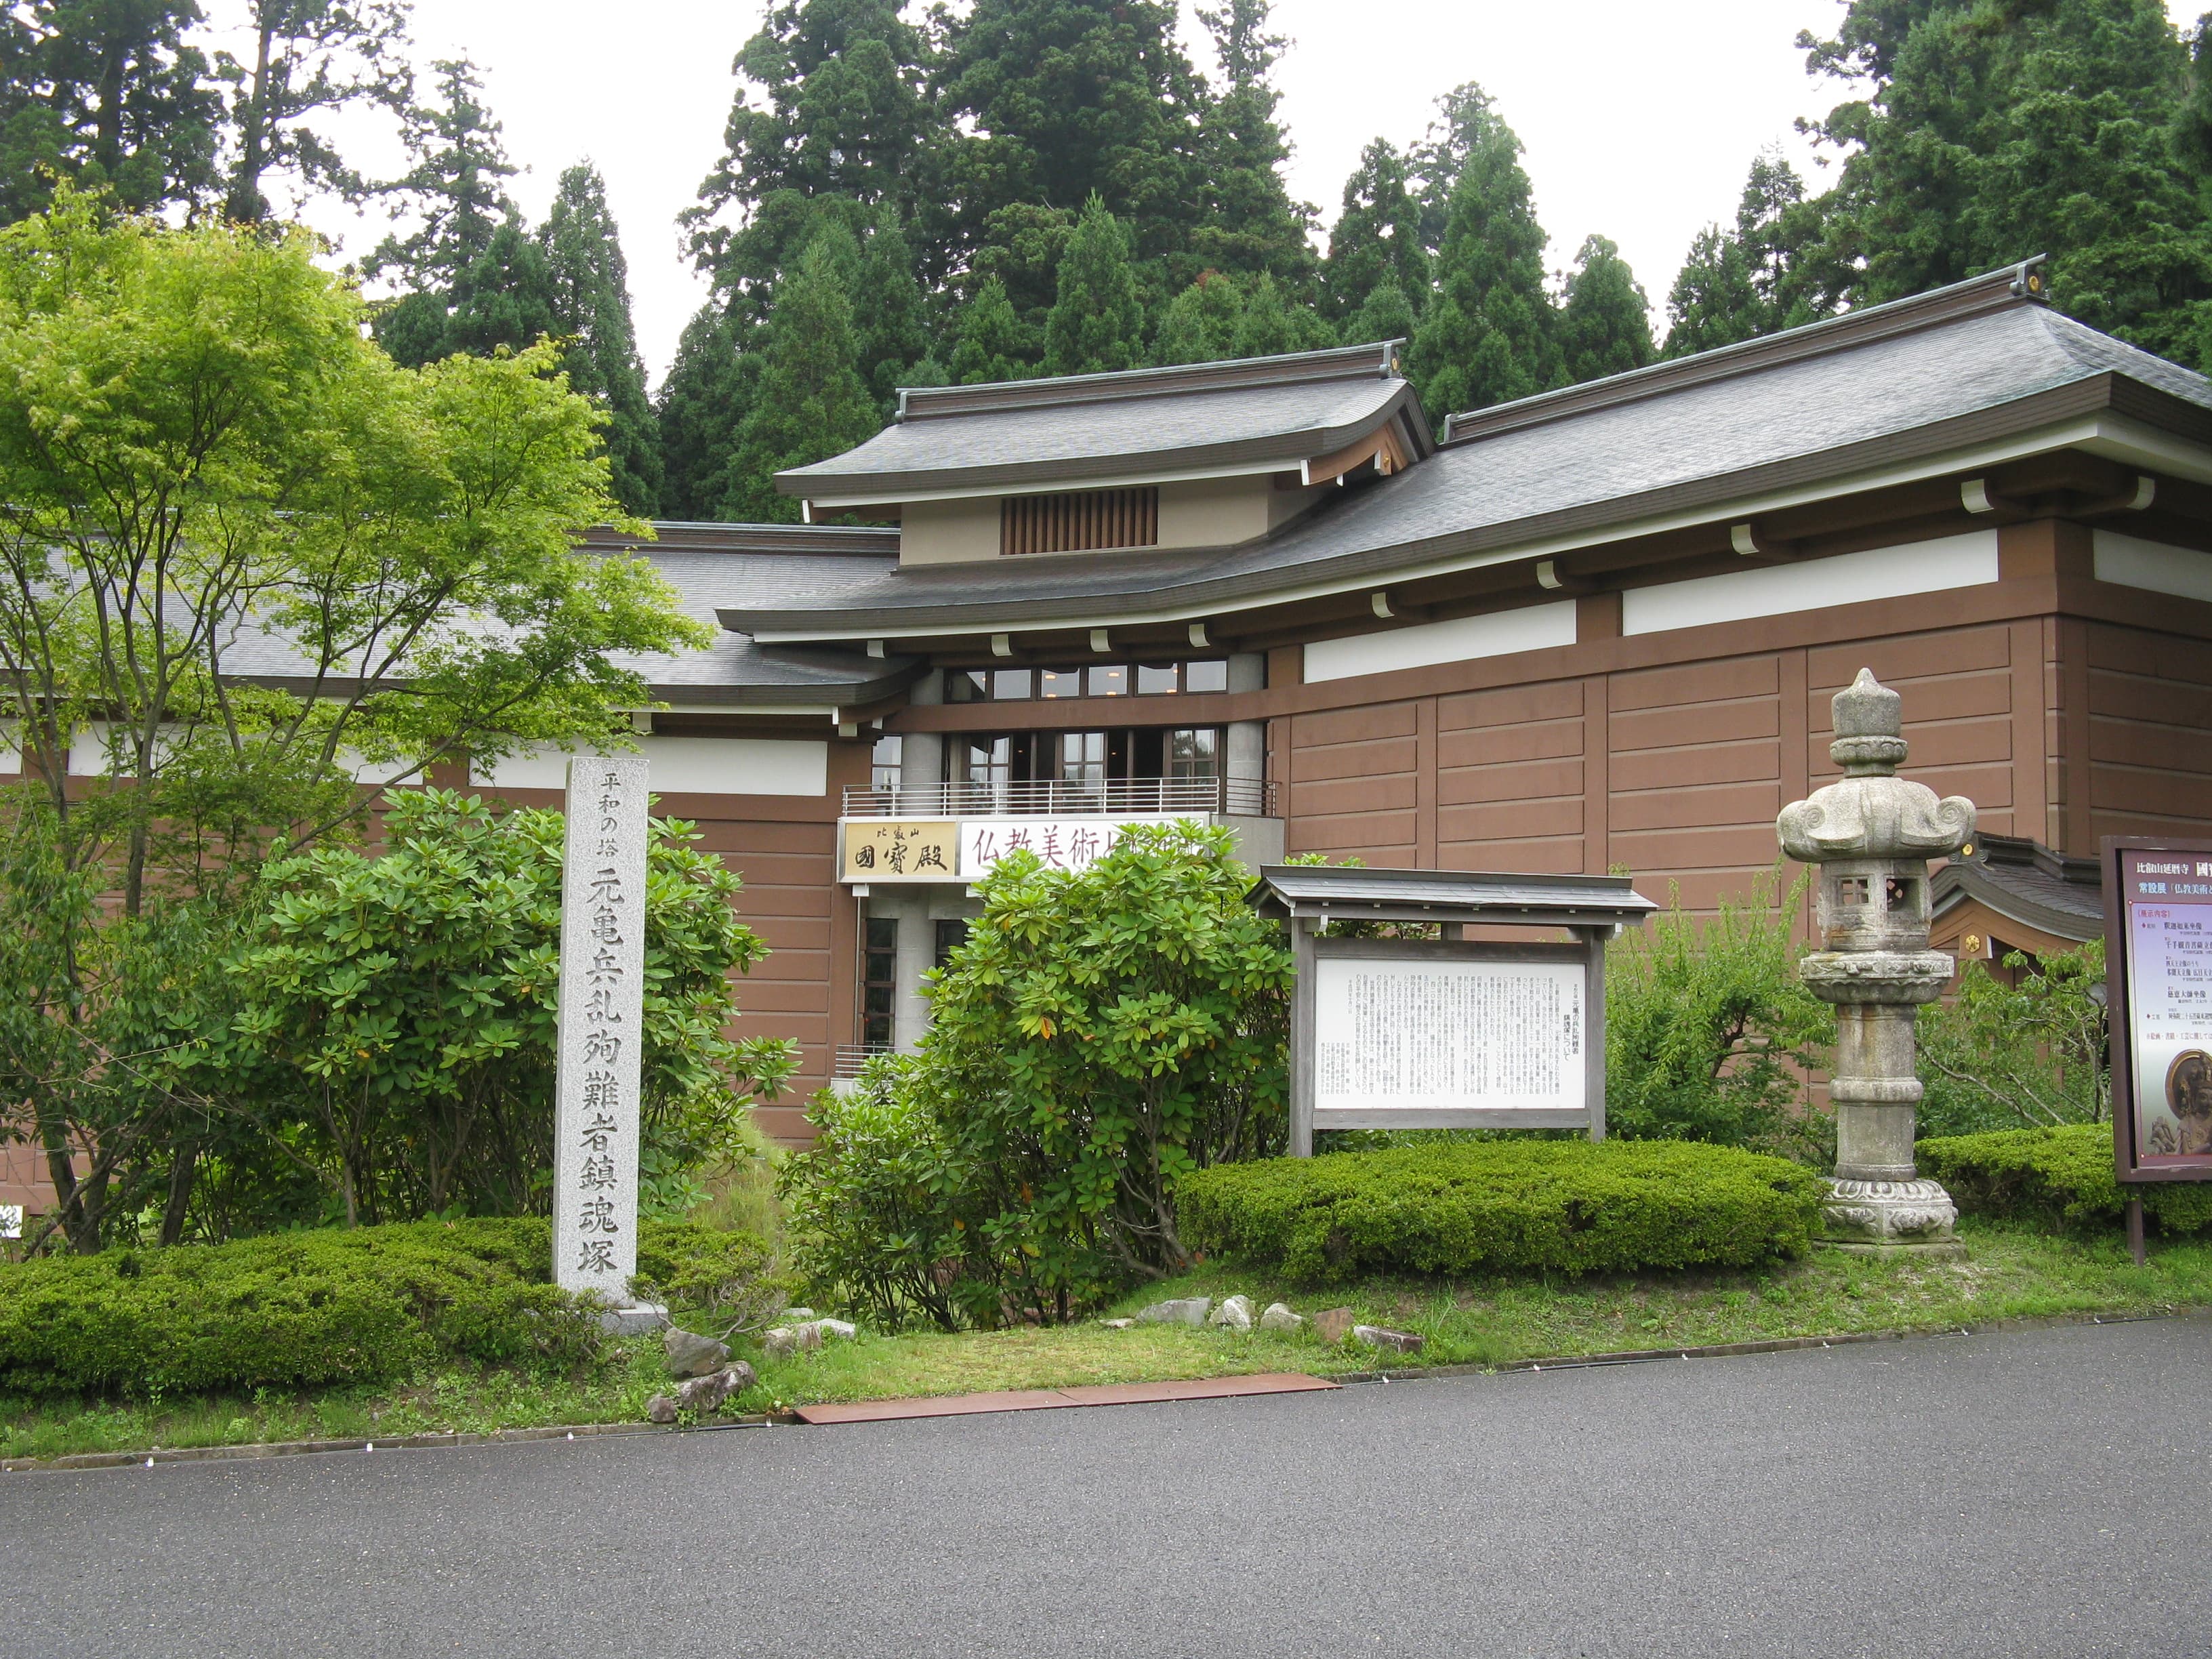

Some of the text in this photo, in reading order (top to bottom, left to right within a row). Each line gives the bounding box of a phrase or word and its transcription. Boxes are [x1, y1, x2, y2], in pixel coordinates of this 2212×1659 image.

[596, 773, 621, 857] 平和の塔
[2136, 862, 2190, 875] 比叡山延暦寺
[2138, 882, 2167, 895] 常設展
